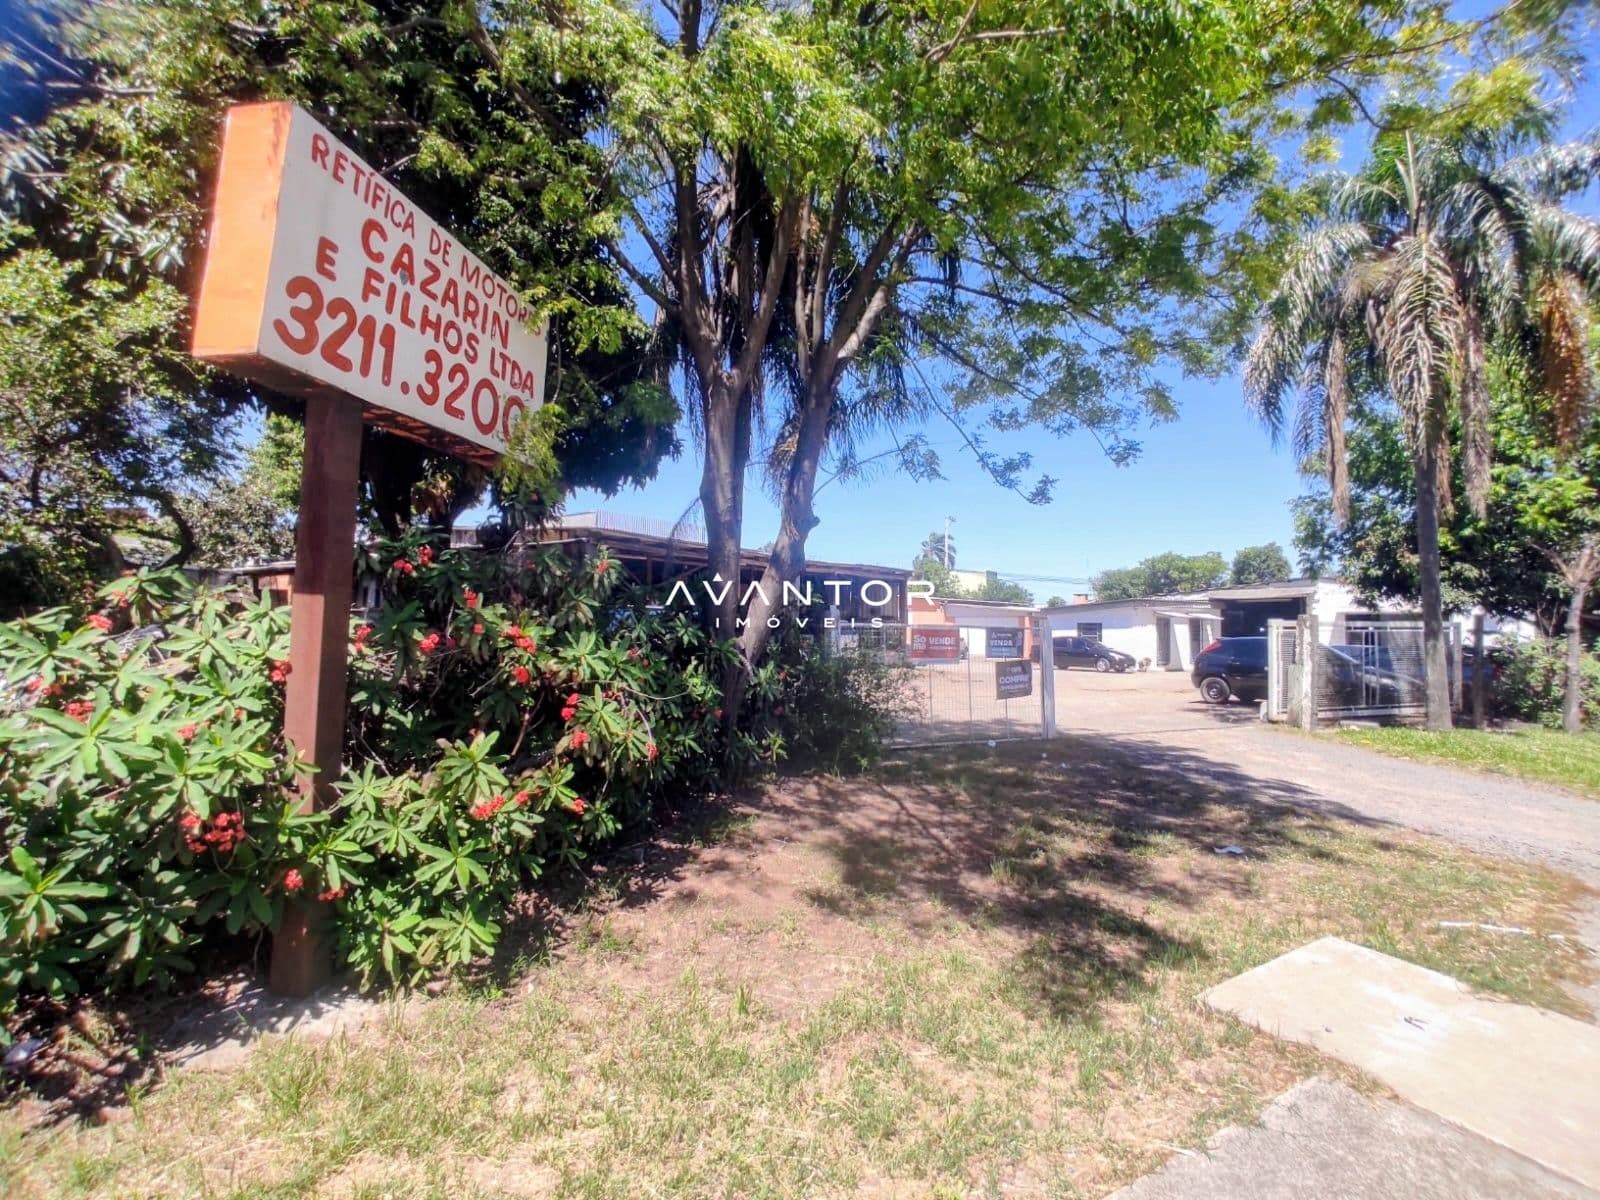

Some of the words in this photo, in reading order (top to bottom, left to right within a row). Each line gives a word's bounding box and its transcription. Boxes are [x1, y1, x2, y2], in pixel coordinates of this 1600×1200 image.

[361, 217, 510, 349] CAZARIN
[429, 232, 452, 266] DE
[316, 236, 339, 281] E
[362, 267, 480, 364] FILHOS
[489, 346, 535, 399] LTDA
